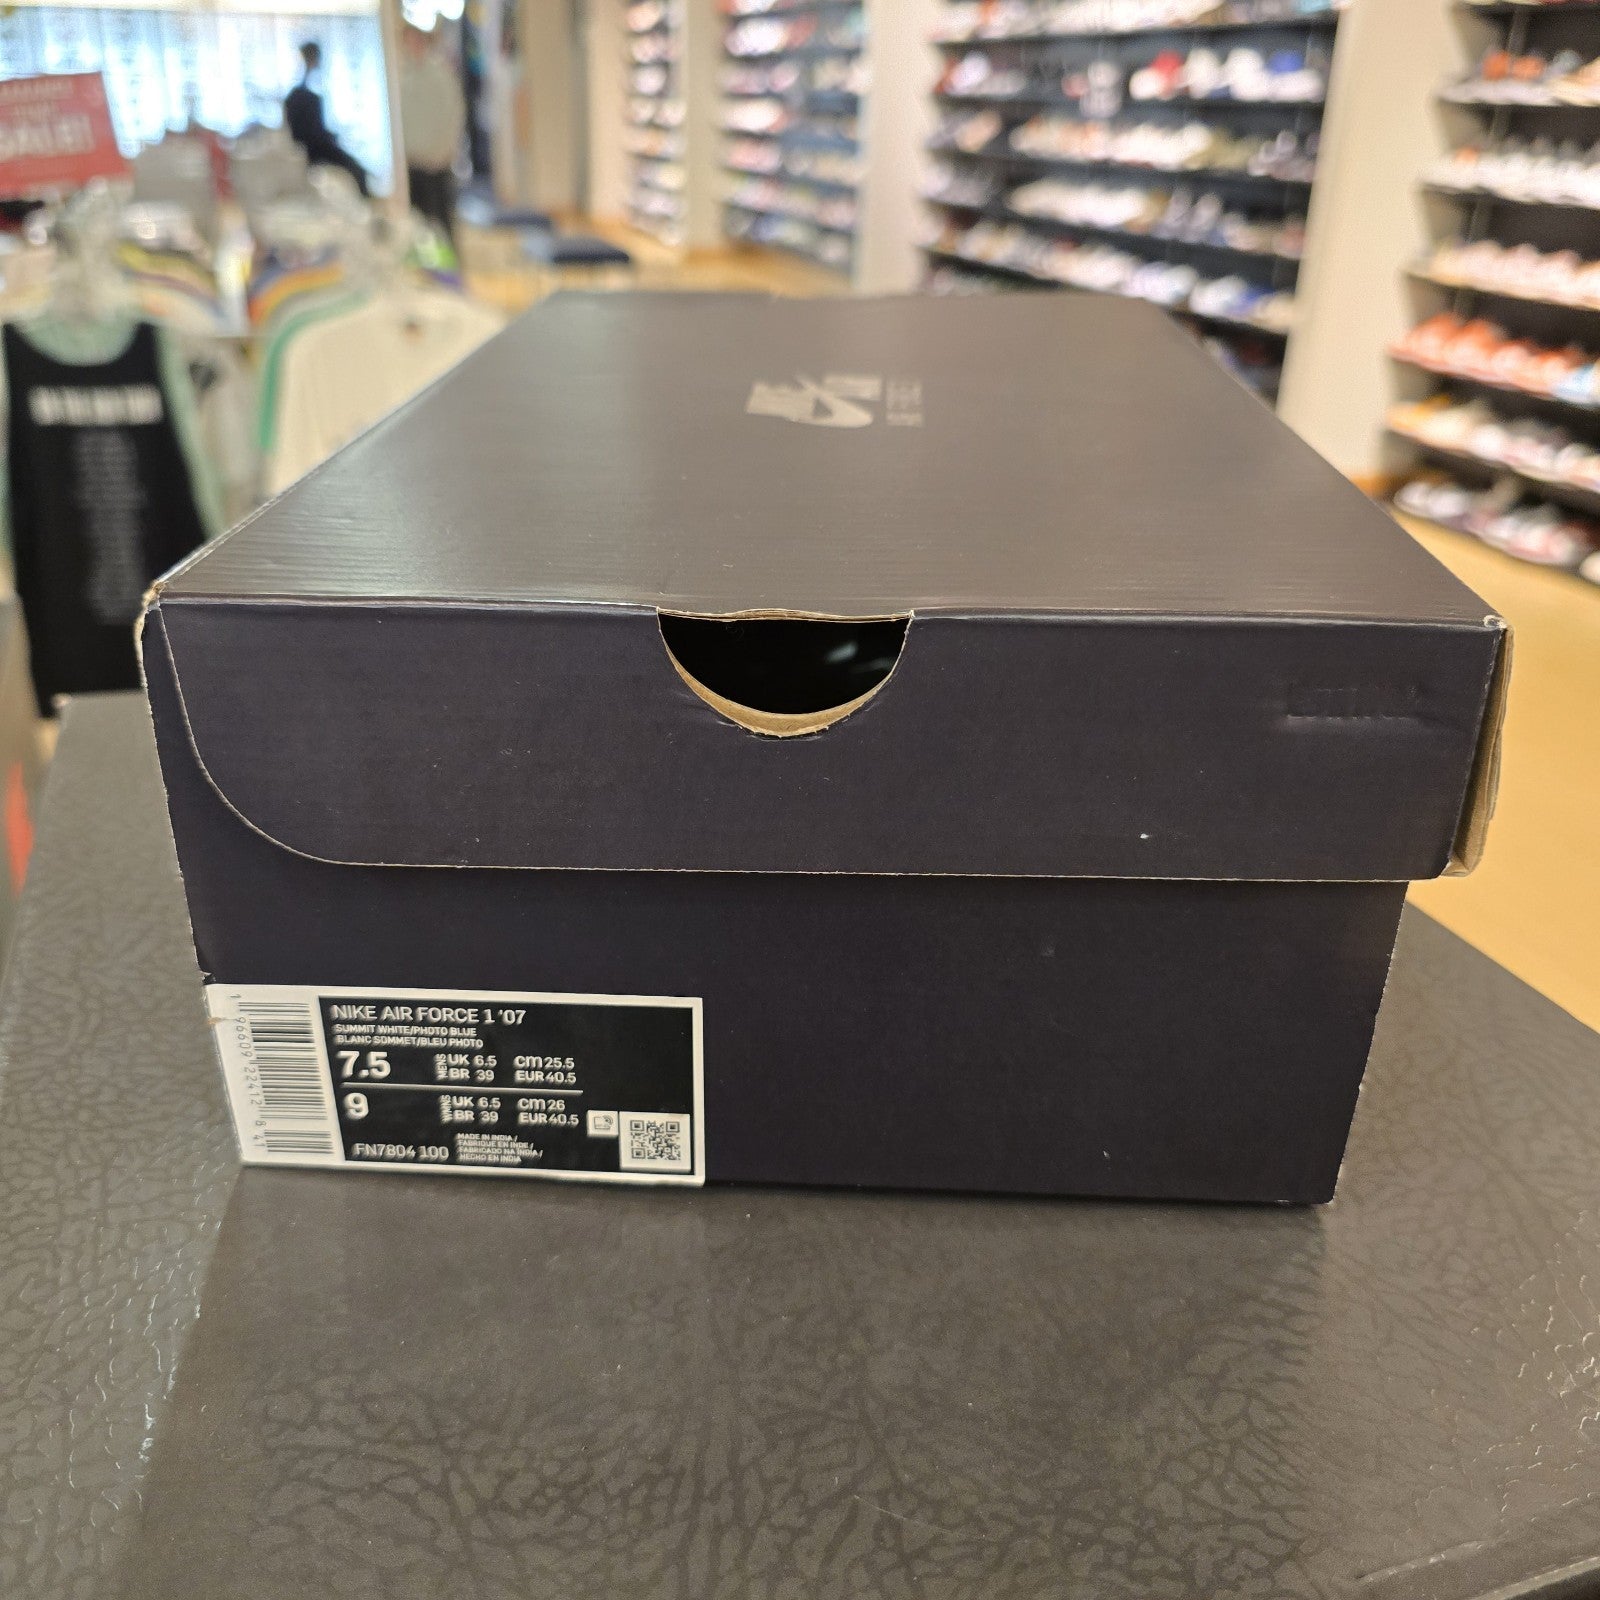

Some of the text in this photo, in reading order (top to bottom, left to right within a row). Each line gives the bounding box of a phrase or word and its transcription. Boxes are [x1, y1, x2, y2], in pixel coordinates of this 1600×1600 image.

[330, 1004, 526, 1026] NIKE AIR FORCE 1 '07
[333, 1023, 478, 1038] SUMMIT WHITE/PHOTO BLUE
[335, 1034, 484, 1050] BLANC SOMMET/BLEU PHOTO
[235, 1016, 253, 1058] 96609
[244, 1066, 262, 1106] 22412
[335, 1050, 392, 1080] 7.5
[434, 1053, 448, 1080] MENS
[447, 1053, 471, 1067] UK
[473, 1055, 498, 1069] 6.5
[543, 1056, 576, 1071] 25.5
[447, 1068, 577, 1086] BR 39 EUR 40.5
[341, 1092, 370, 1121] 9
[439, 1094, 453, 1124] WMNS
[451, 1096, 475, 1109] UK
[477, 1097, 502, 1111] 6.5
[547, 1099, 567, 1113] 26
[451, 1110, 580, 1128] BR 39 EUR 40.5
[456, 1133, 481, 1141] MADE
[491, 1134, 514, 1142] INDIA
[497, 1141, 509, 1149] EN
[510, 1142, 529, 1150] INDE
[353, 1143, 450, 1161] FN7804 100
[487, 1155, 500, 1163] EN
